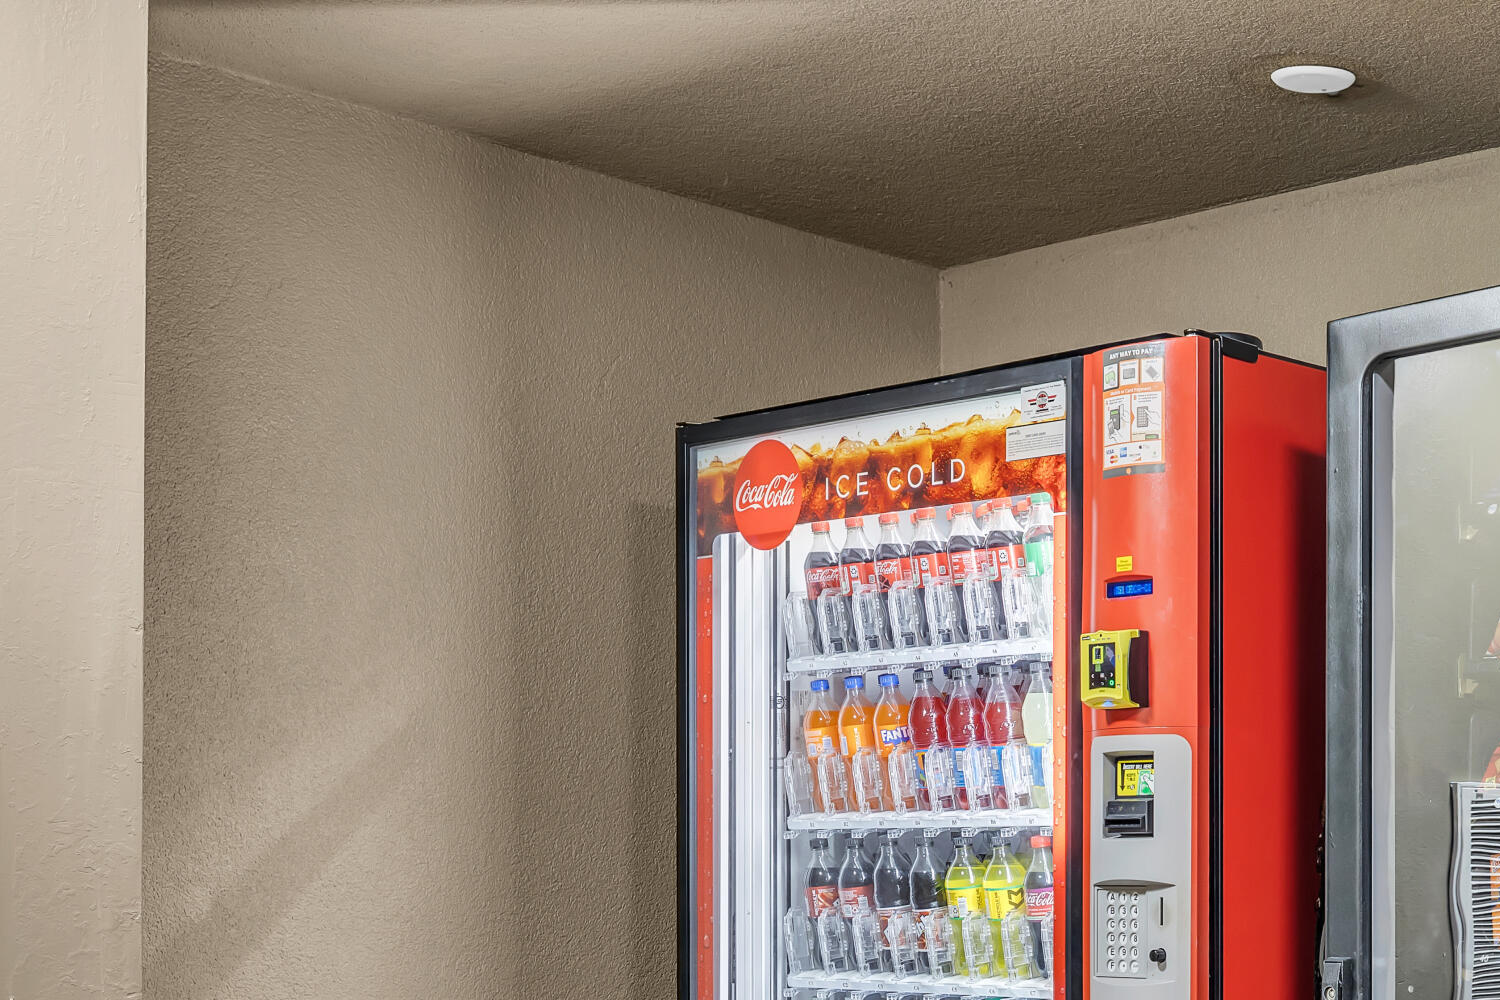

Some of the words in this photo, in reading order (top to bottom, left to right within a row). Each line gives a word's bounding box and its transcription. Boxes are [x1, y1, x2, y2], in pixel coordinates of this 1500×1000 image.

[825, 472, 869, 500] ICE
[887, 458, 966, 492] COLD
[735, 472, 798, 512] Coca-Cola
[1110, 906, 1115, 915] B
[1122, 907, 1127, 915] 3
[1133, 907, 1138, 915] 4
[1110, 920, 1115, 928] C
[1122, 920, 1127, 928] 5
[1133, 920, 1138, 929] 6
[1110, 934, 1115, 942] D
[1110, 948, 1115, 956] E
[1122, 948, 1127, 956] 9
[1134, 948, 1138, 956] 0
